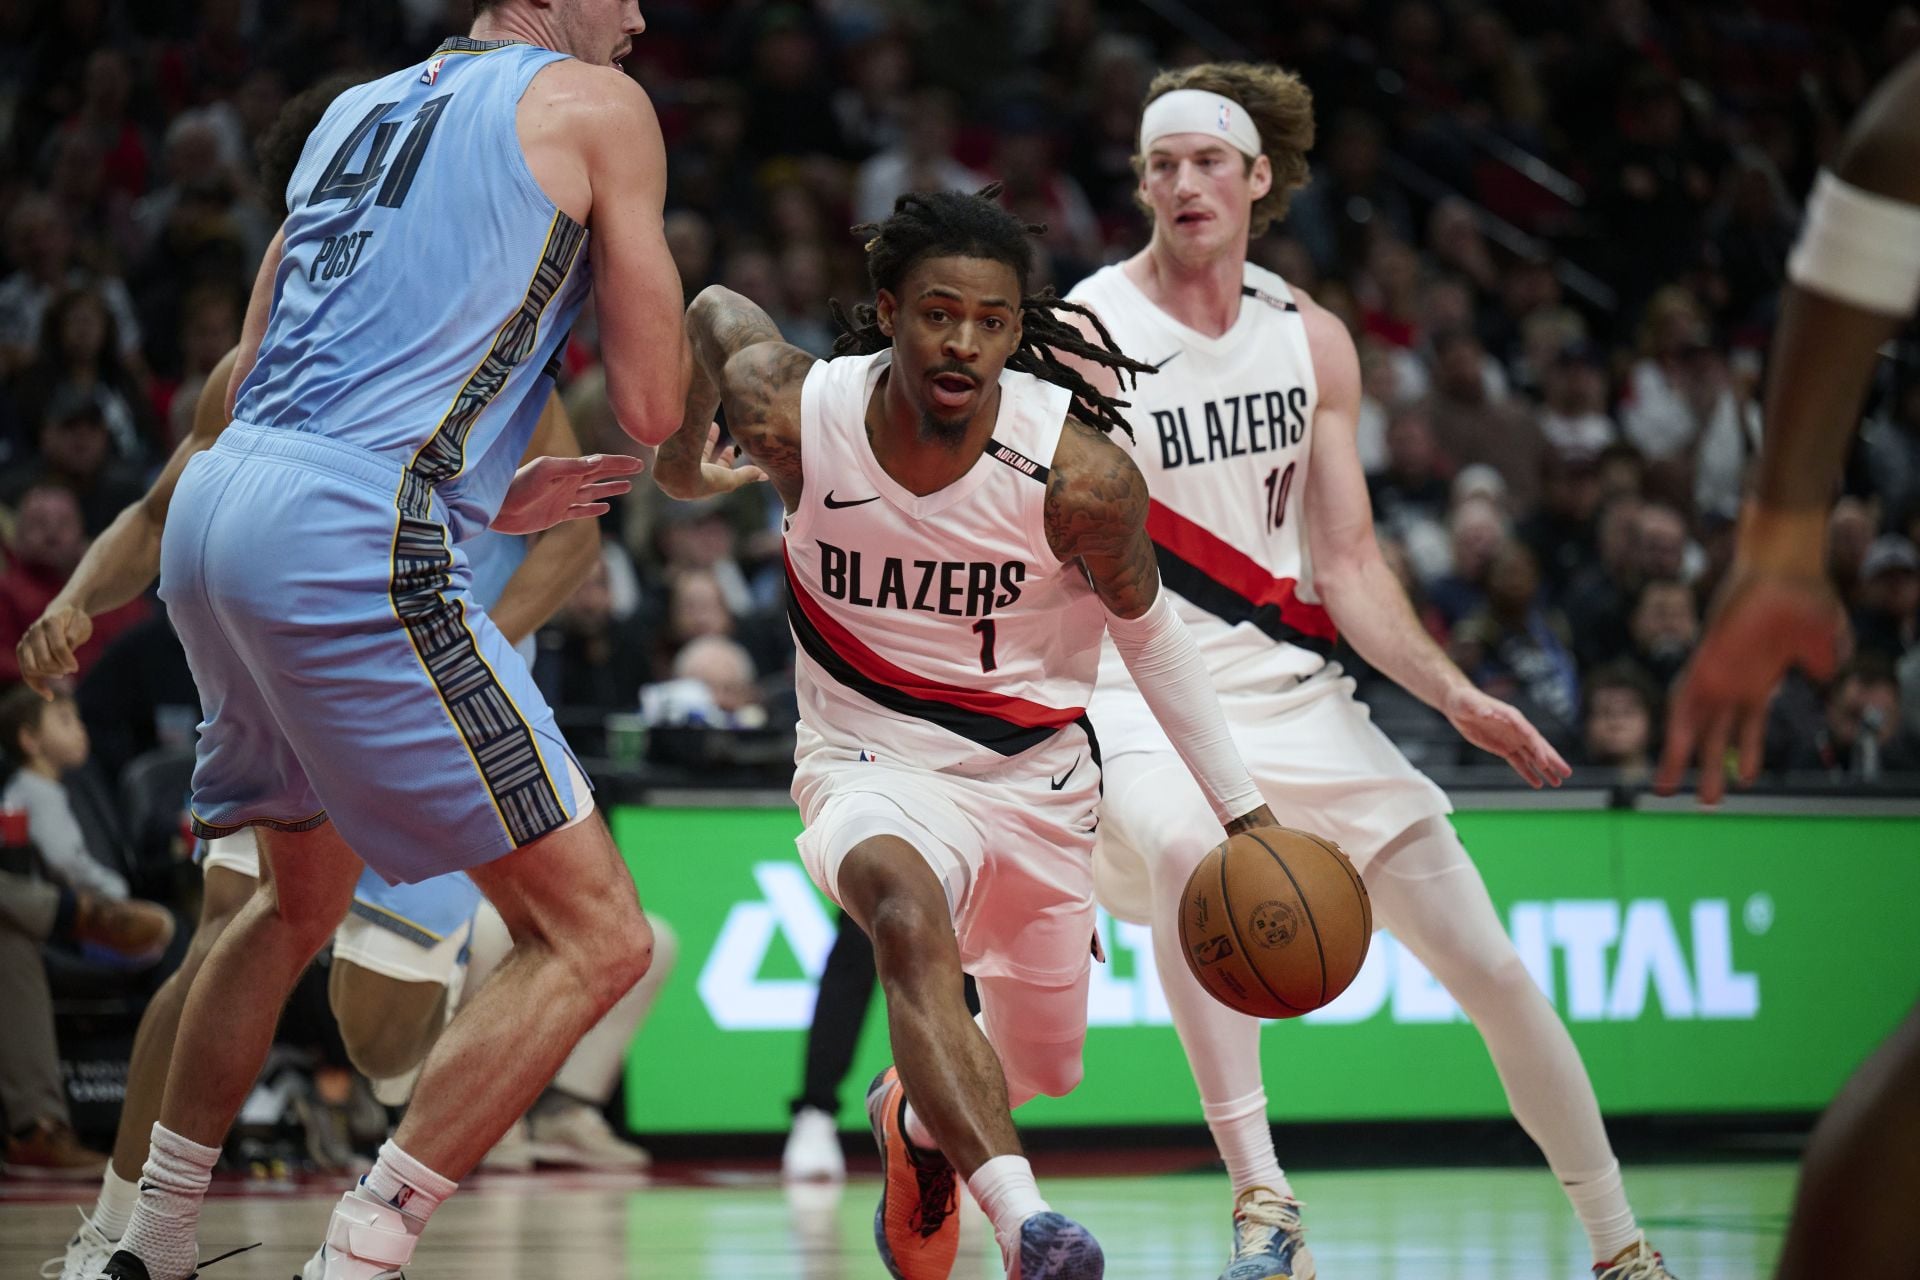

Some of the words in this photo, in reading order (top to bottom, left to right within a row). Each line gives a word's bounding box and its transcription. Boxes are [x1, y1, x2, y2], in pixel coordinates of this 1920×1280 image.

[306, 92, 455, 213] 41
[309, 230, 374, 283] POST
[994, 446, 1039, 475] ADELMAN
[1150, 387, 1307, 470] BLAZERS
[1264, 461, 1296, 535] 10
[815, 538, 1026, 617] BLAZERS
[971, 618, 998, 674] 1
